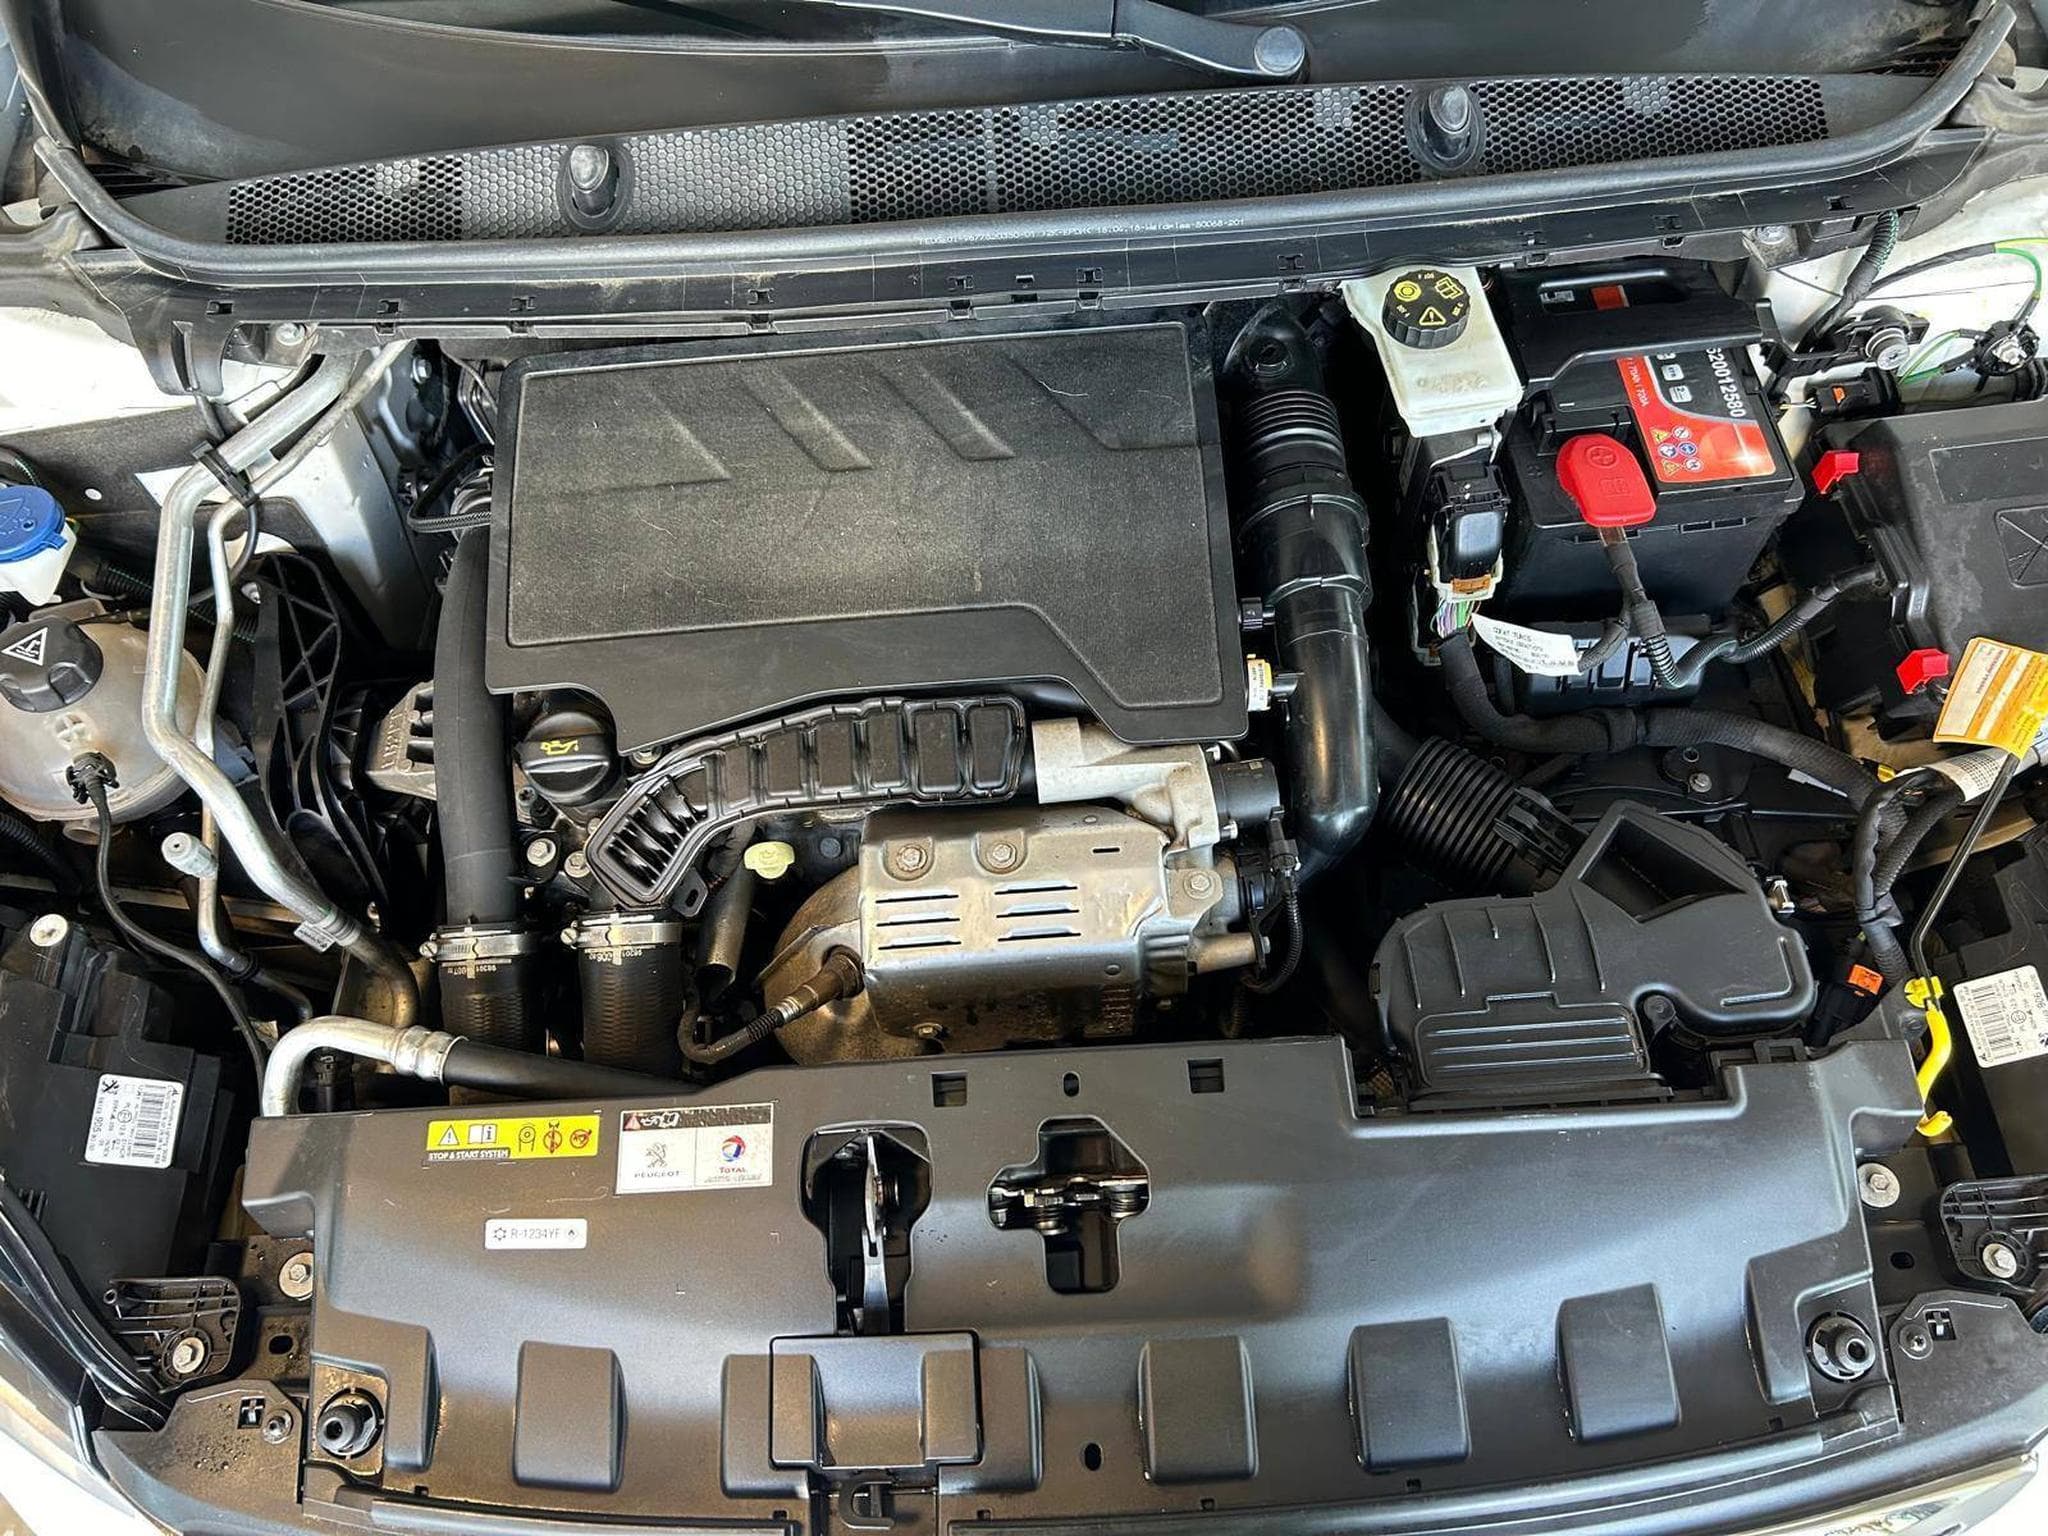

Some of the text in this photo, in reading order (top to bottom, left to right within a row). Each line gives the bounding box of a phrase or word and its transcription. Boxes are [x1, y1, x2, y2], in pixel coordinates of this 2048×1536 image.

[429, 1152, 449, 1161] STOP
[456, 1150, 478, 1160] START
[480, 1149, 509, 1159] SYSTEM
[634, 1170, 680, 1179] PEUGEOT
[719, 1166, 746, 1174] TOTAL
[510, 1228, 561, 1240] R-1234YF
